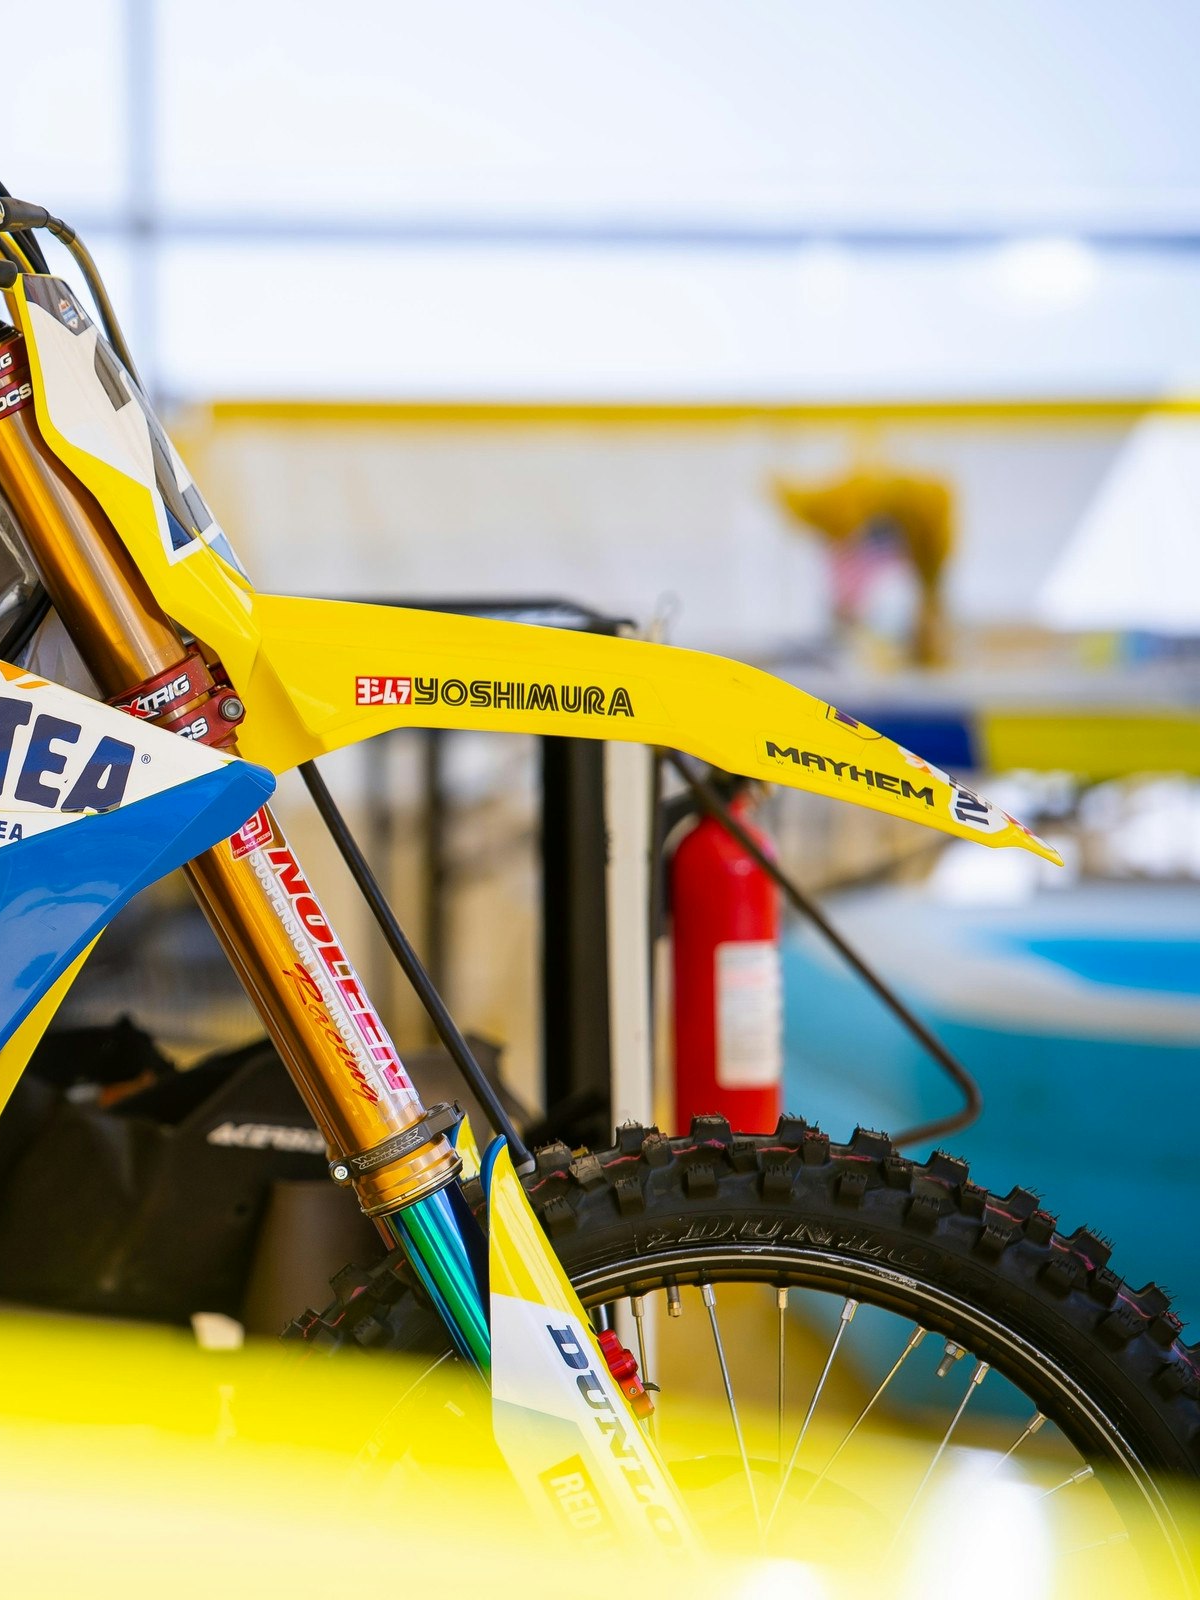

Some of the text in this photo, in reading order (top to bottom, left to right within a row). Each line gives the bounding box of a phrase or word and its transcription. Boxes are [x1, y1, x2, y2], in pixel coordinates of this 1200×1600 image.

[116, 673, 191, 719] XTRIG
[357, 678, 411, 705] ヨシムラ
[414, 677, 635, 717] YOSHIMURA
[766, 740, 935, 807] MAYHEM
[248, 850, 315, 967] SUSPENSION
[264, 848, 416, 1094] NOLEEN
[282, 963, 379, 1107] Racing
[546, 1324, 688, 1556] DUNLO
